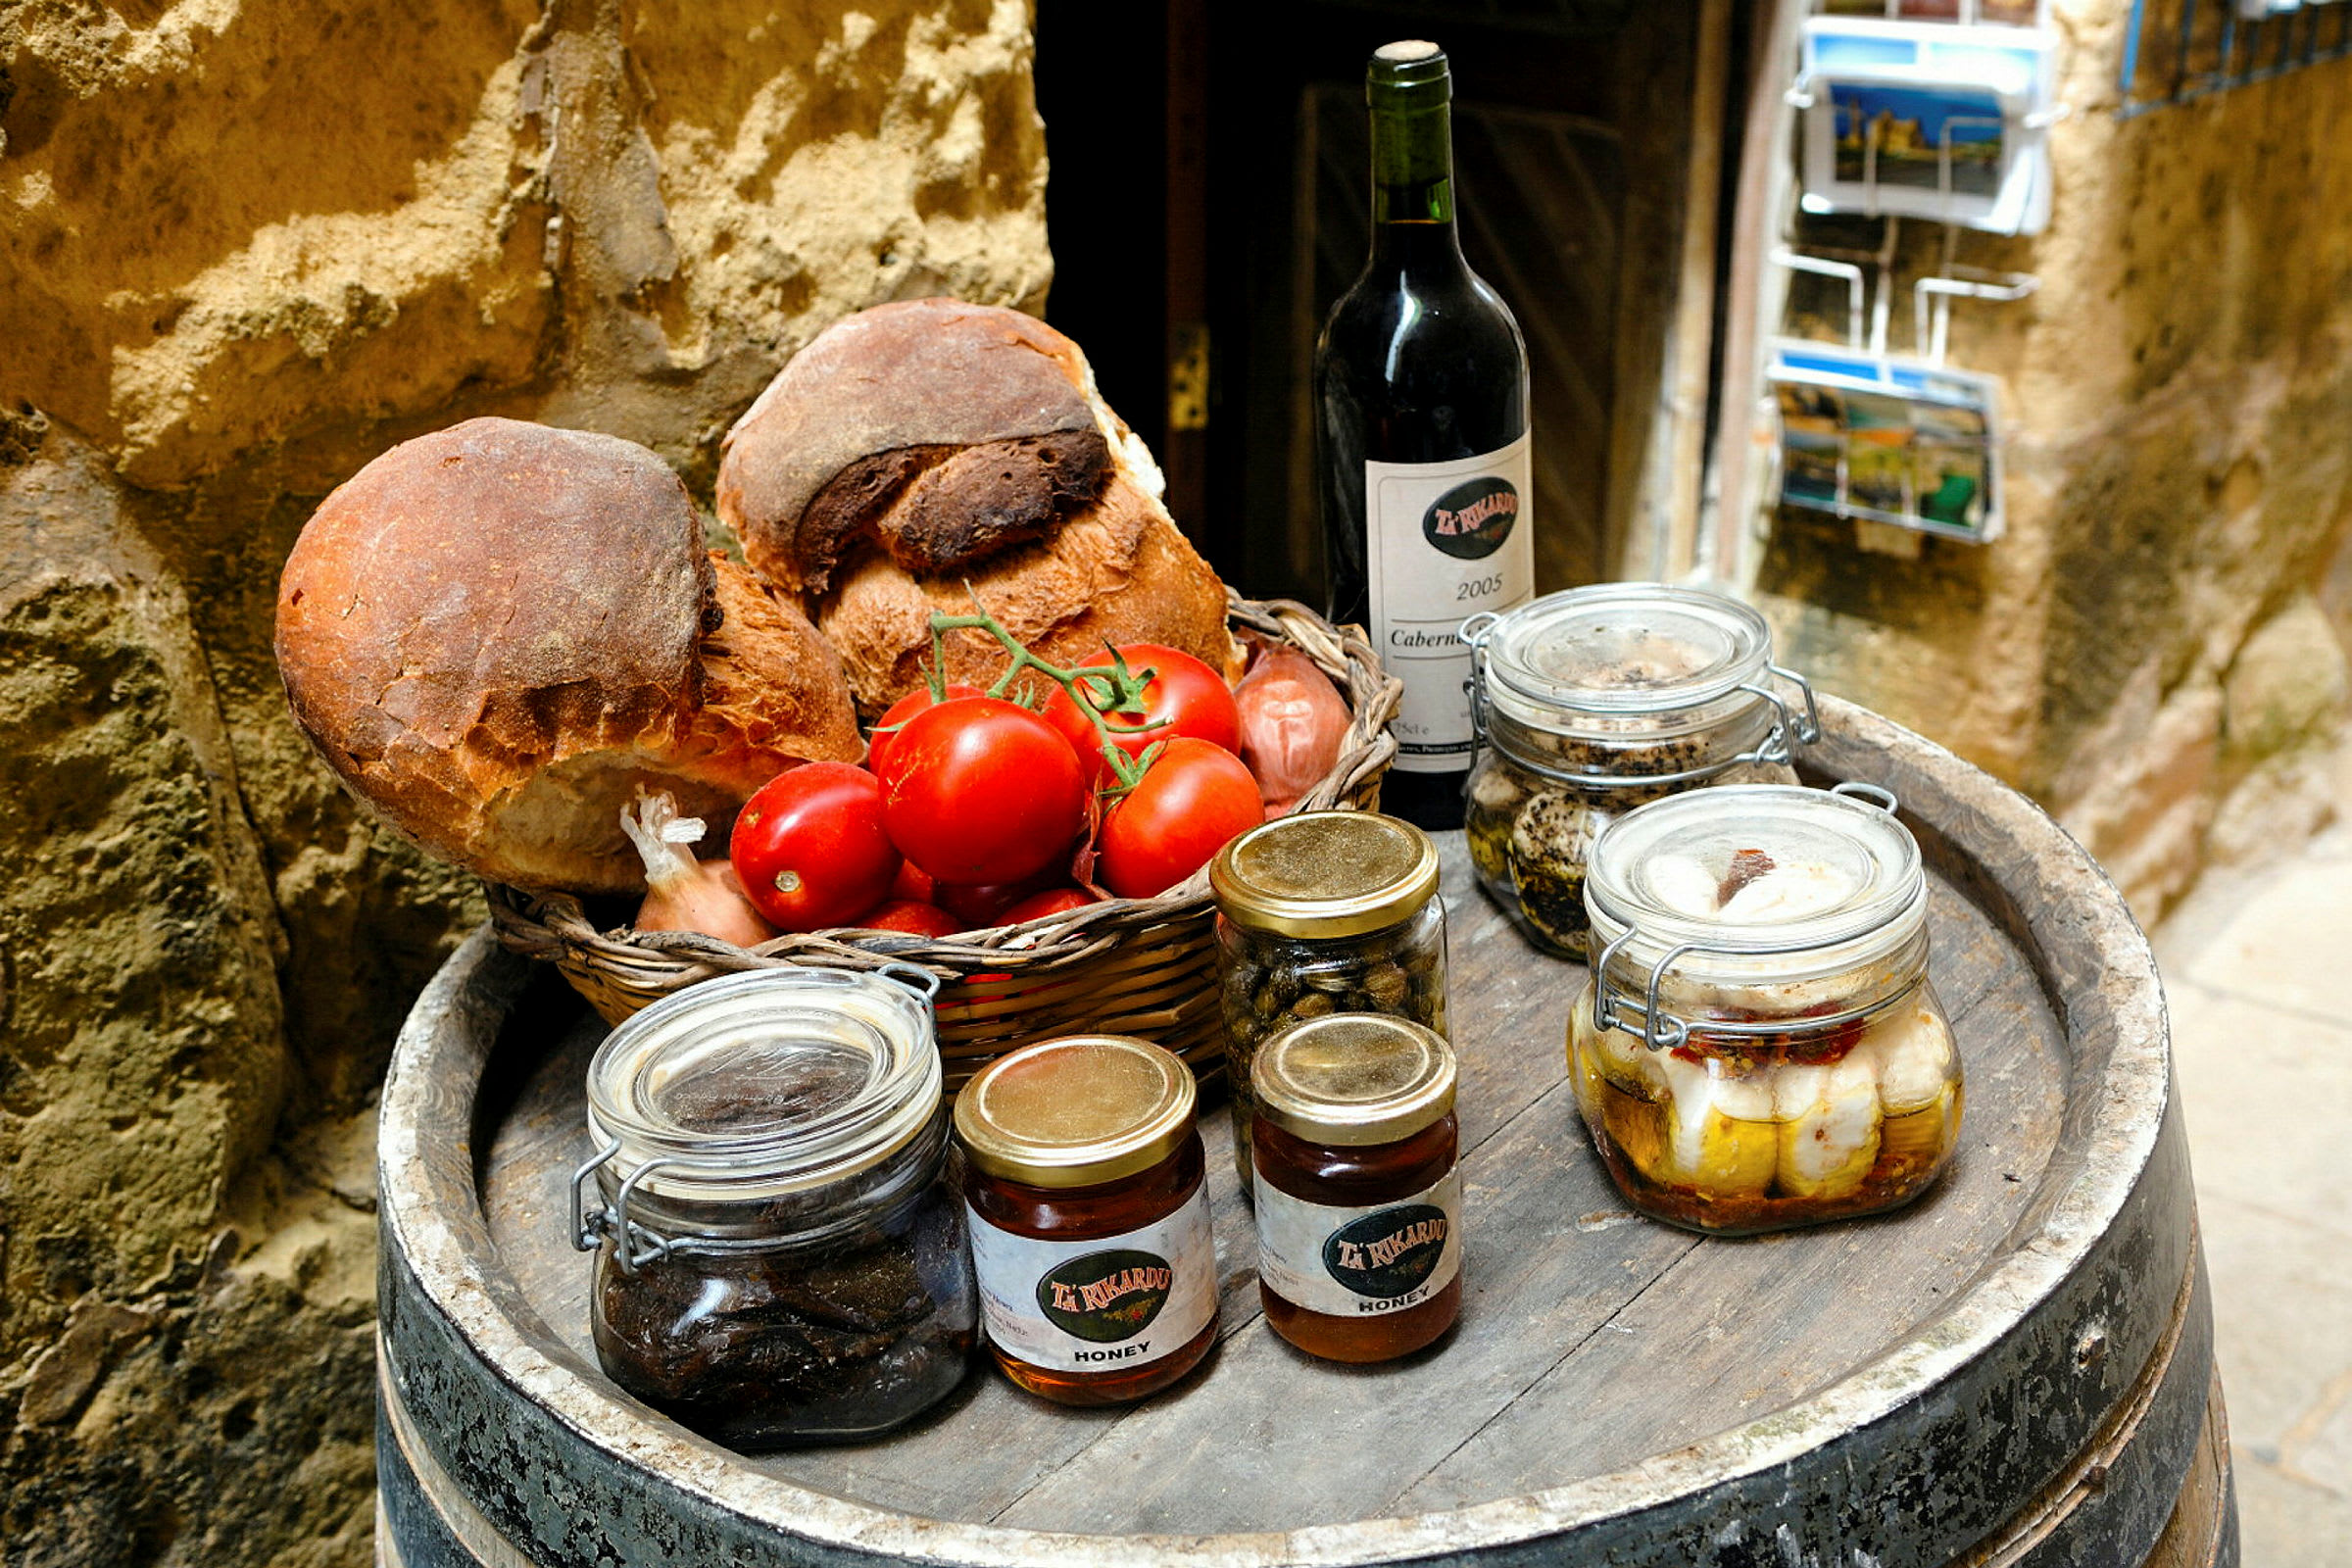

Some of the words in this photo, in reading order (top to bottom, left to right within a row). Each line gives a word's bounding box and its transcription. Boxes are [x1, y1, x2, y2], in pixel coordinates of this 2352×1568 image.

[1456, 572, 1502, 601] 2005
[1392, 629, 1471, 647] Cabern
[1366, 1219, 1447, 1269] RIKARDU
[1079, 1267, 1171, 1312] RIKARDU
[1359, 1286, 1430, 1312] HONEY
[1075, 1341, 1151, 1362] HONEY
